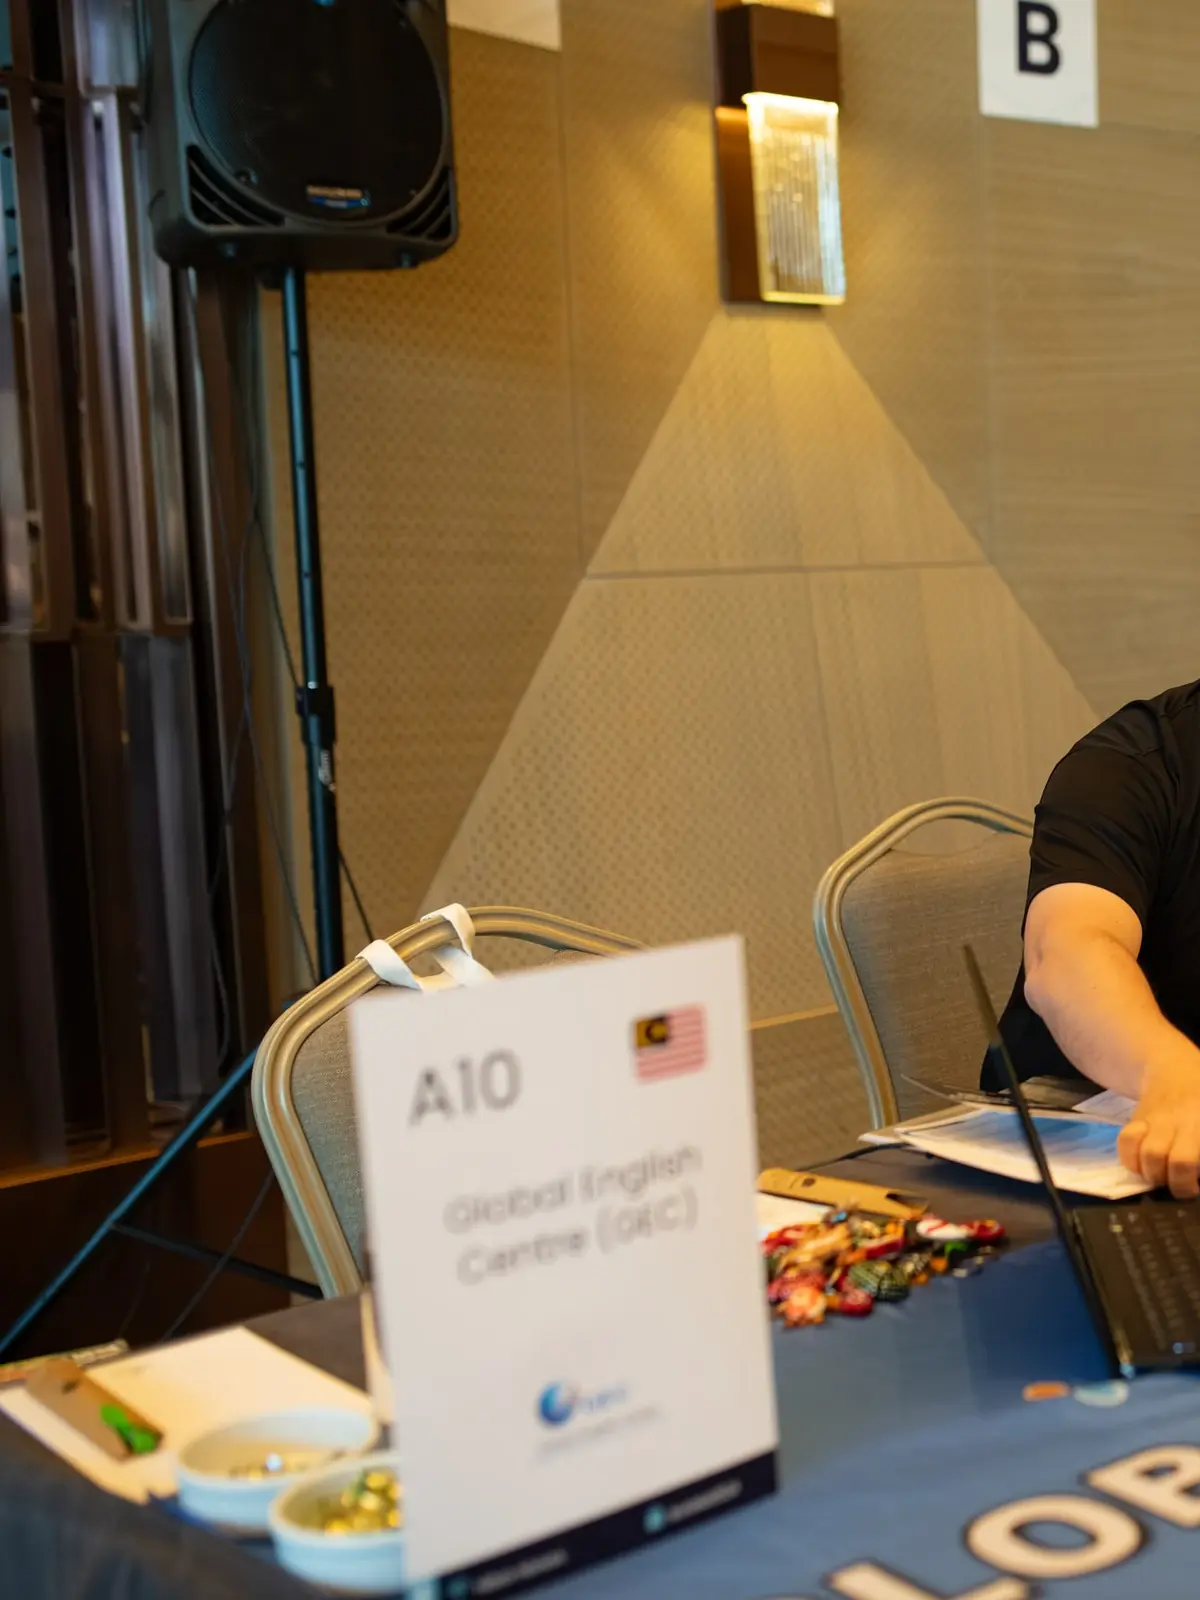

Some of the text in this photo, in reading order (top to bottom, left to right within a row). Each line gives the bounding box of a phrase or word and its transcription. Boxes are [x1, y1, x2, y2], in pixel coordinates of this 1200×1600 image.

[1018, 0, 1060, 74] B
[407, 1047, 522, 1126] A10
[442, 1170, 573, 1234] Global
[456, 1228, 590, 1285] Centre
